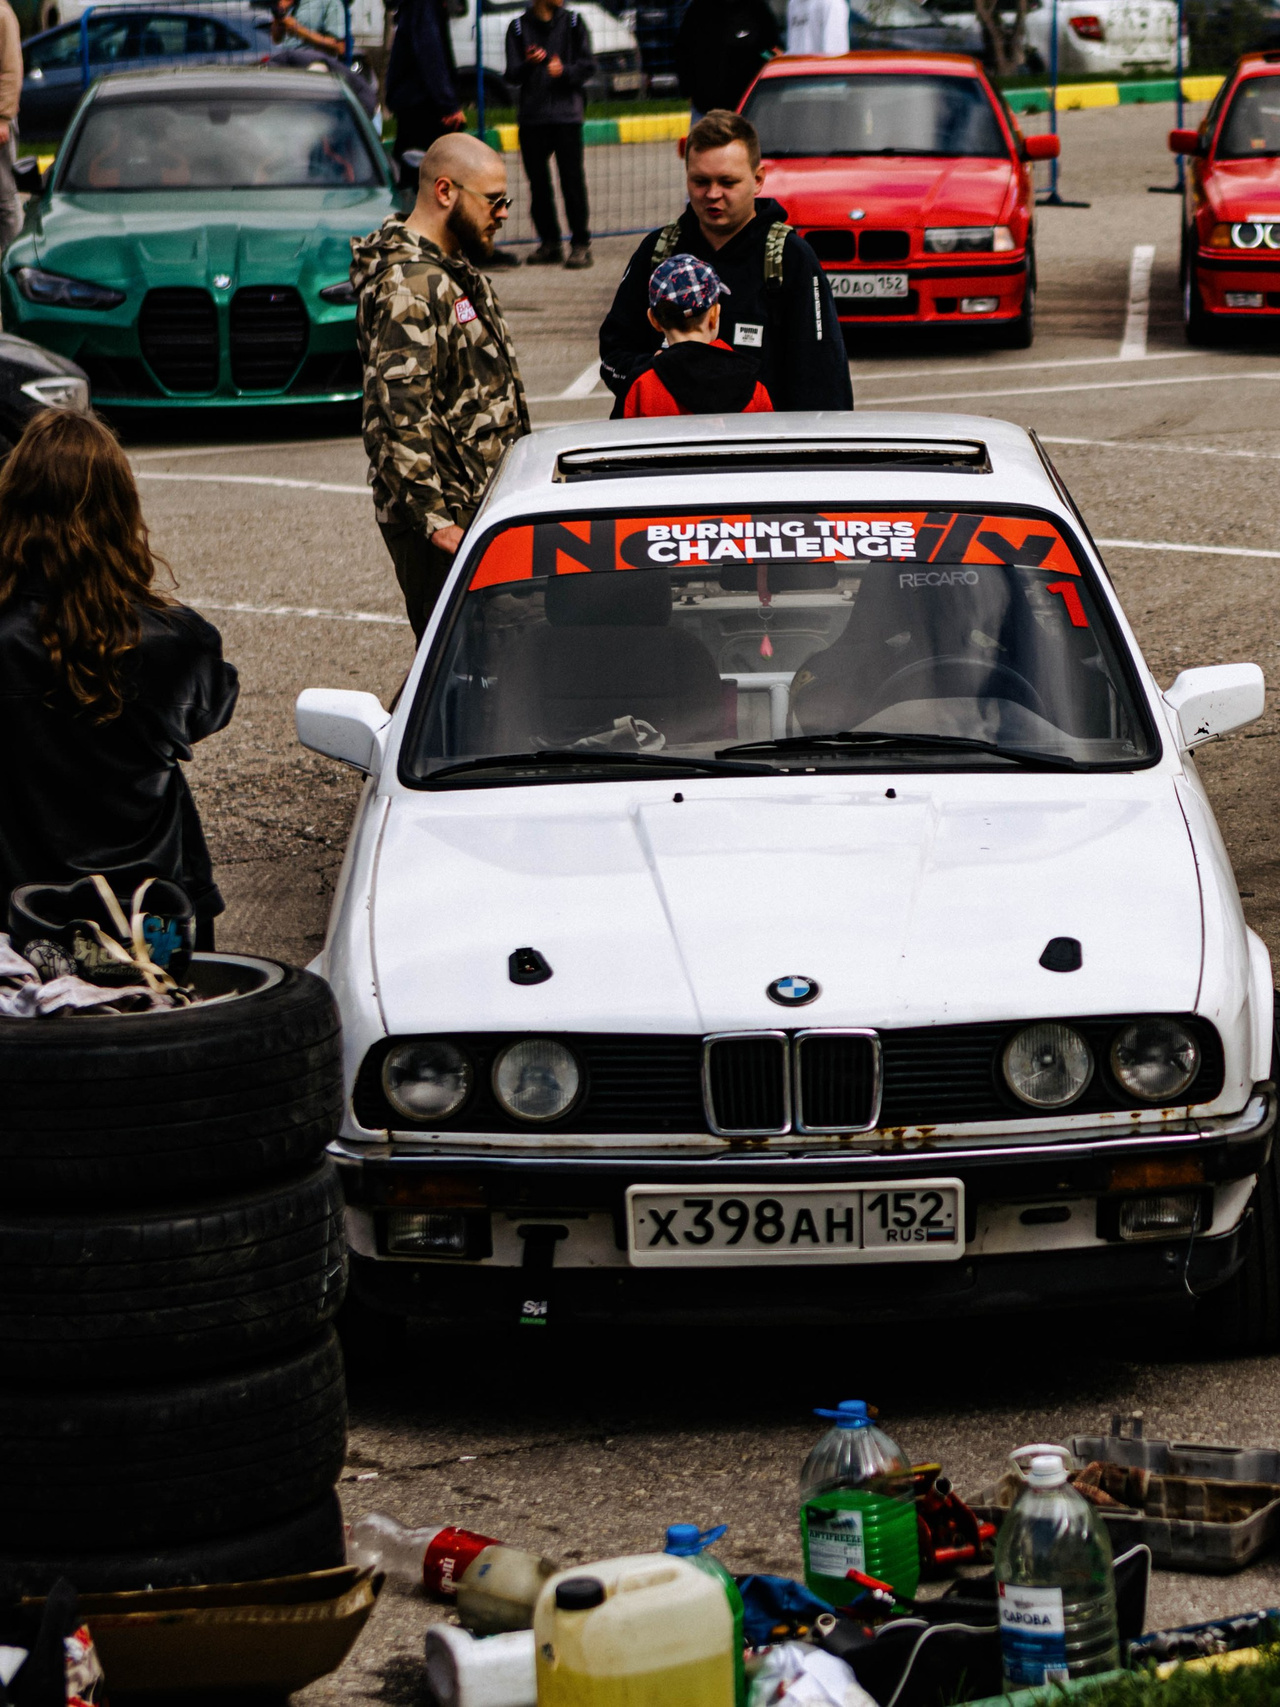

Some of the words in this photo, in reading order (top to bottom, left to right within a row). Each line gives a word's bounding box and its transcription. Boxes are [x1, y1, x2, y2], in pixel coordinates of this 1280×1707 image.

[878, 276, 902, 290] 152
[647, 521, 805, 542] BURNING
[814, 520, 916, 538] TIRES
[646, 537, 917, 563] CHALLENGE
[899, 570, 980, 589] RECARO
[1046, 581, 1090, 628] 1
[867, 1191, 944, 1229] 152
[886, 1228, 926, 1243] RUS
[809, 1529, 862, 1544] ANTIFREEZE
